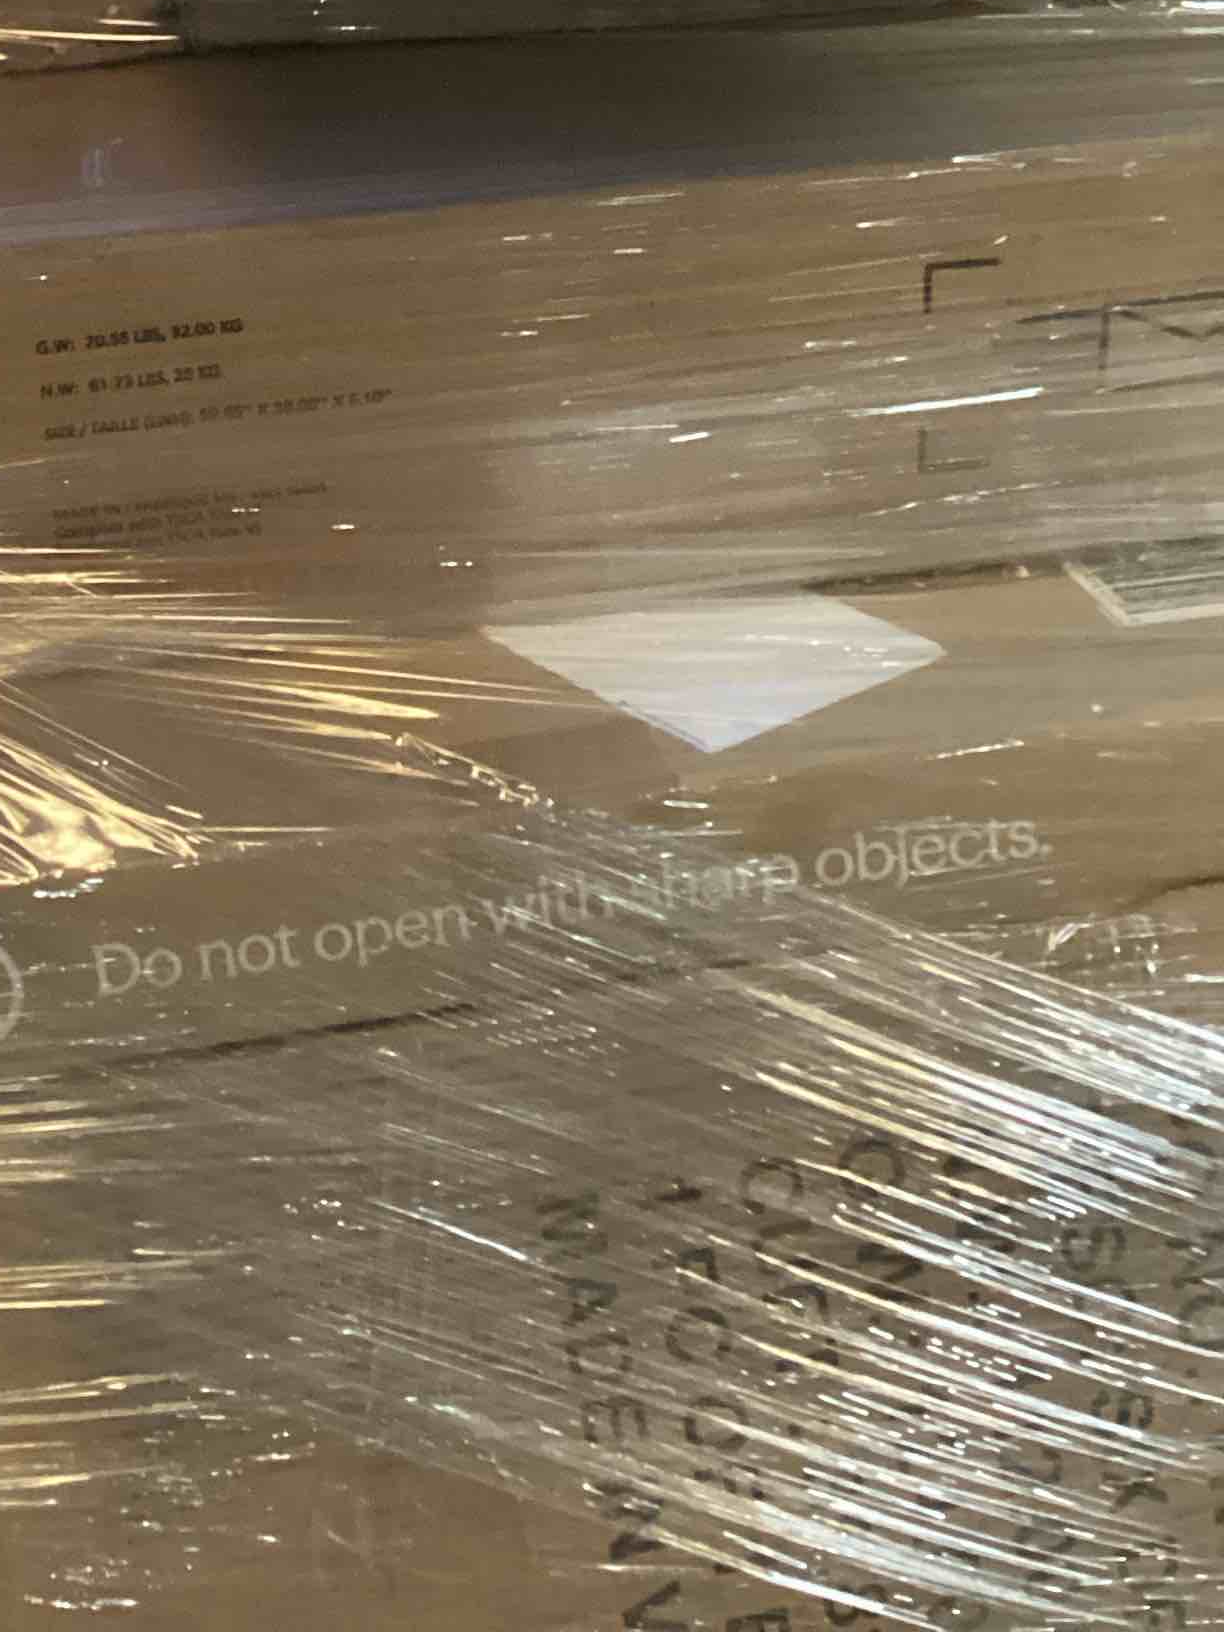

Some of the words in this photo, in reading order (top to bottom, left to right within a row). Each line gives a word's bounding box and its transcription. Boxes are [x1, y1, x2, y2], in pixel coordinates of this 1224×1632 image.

[89, 941, 182, 998] Do
[199, 928, 302, 982] not
[313, 903, 474, 969] open
[481, 870, 616, 935] with
[632, 852, 801, 908] sharp
[815, 818, 1053, 890] objects.
